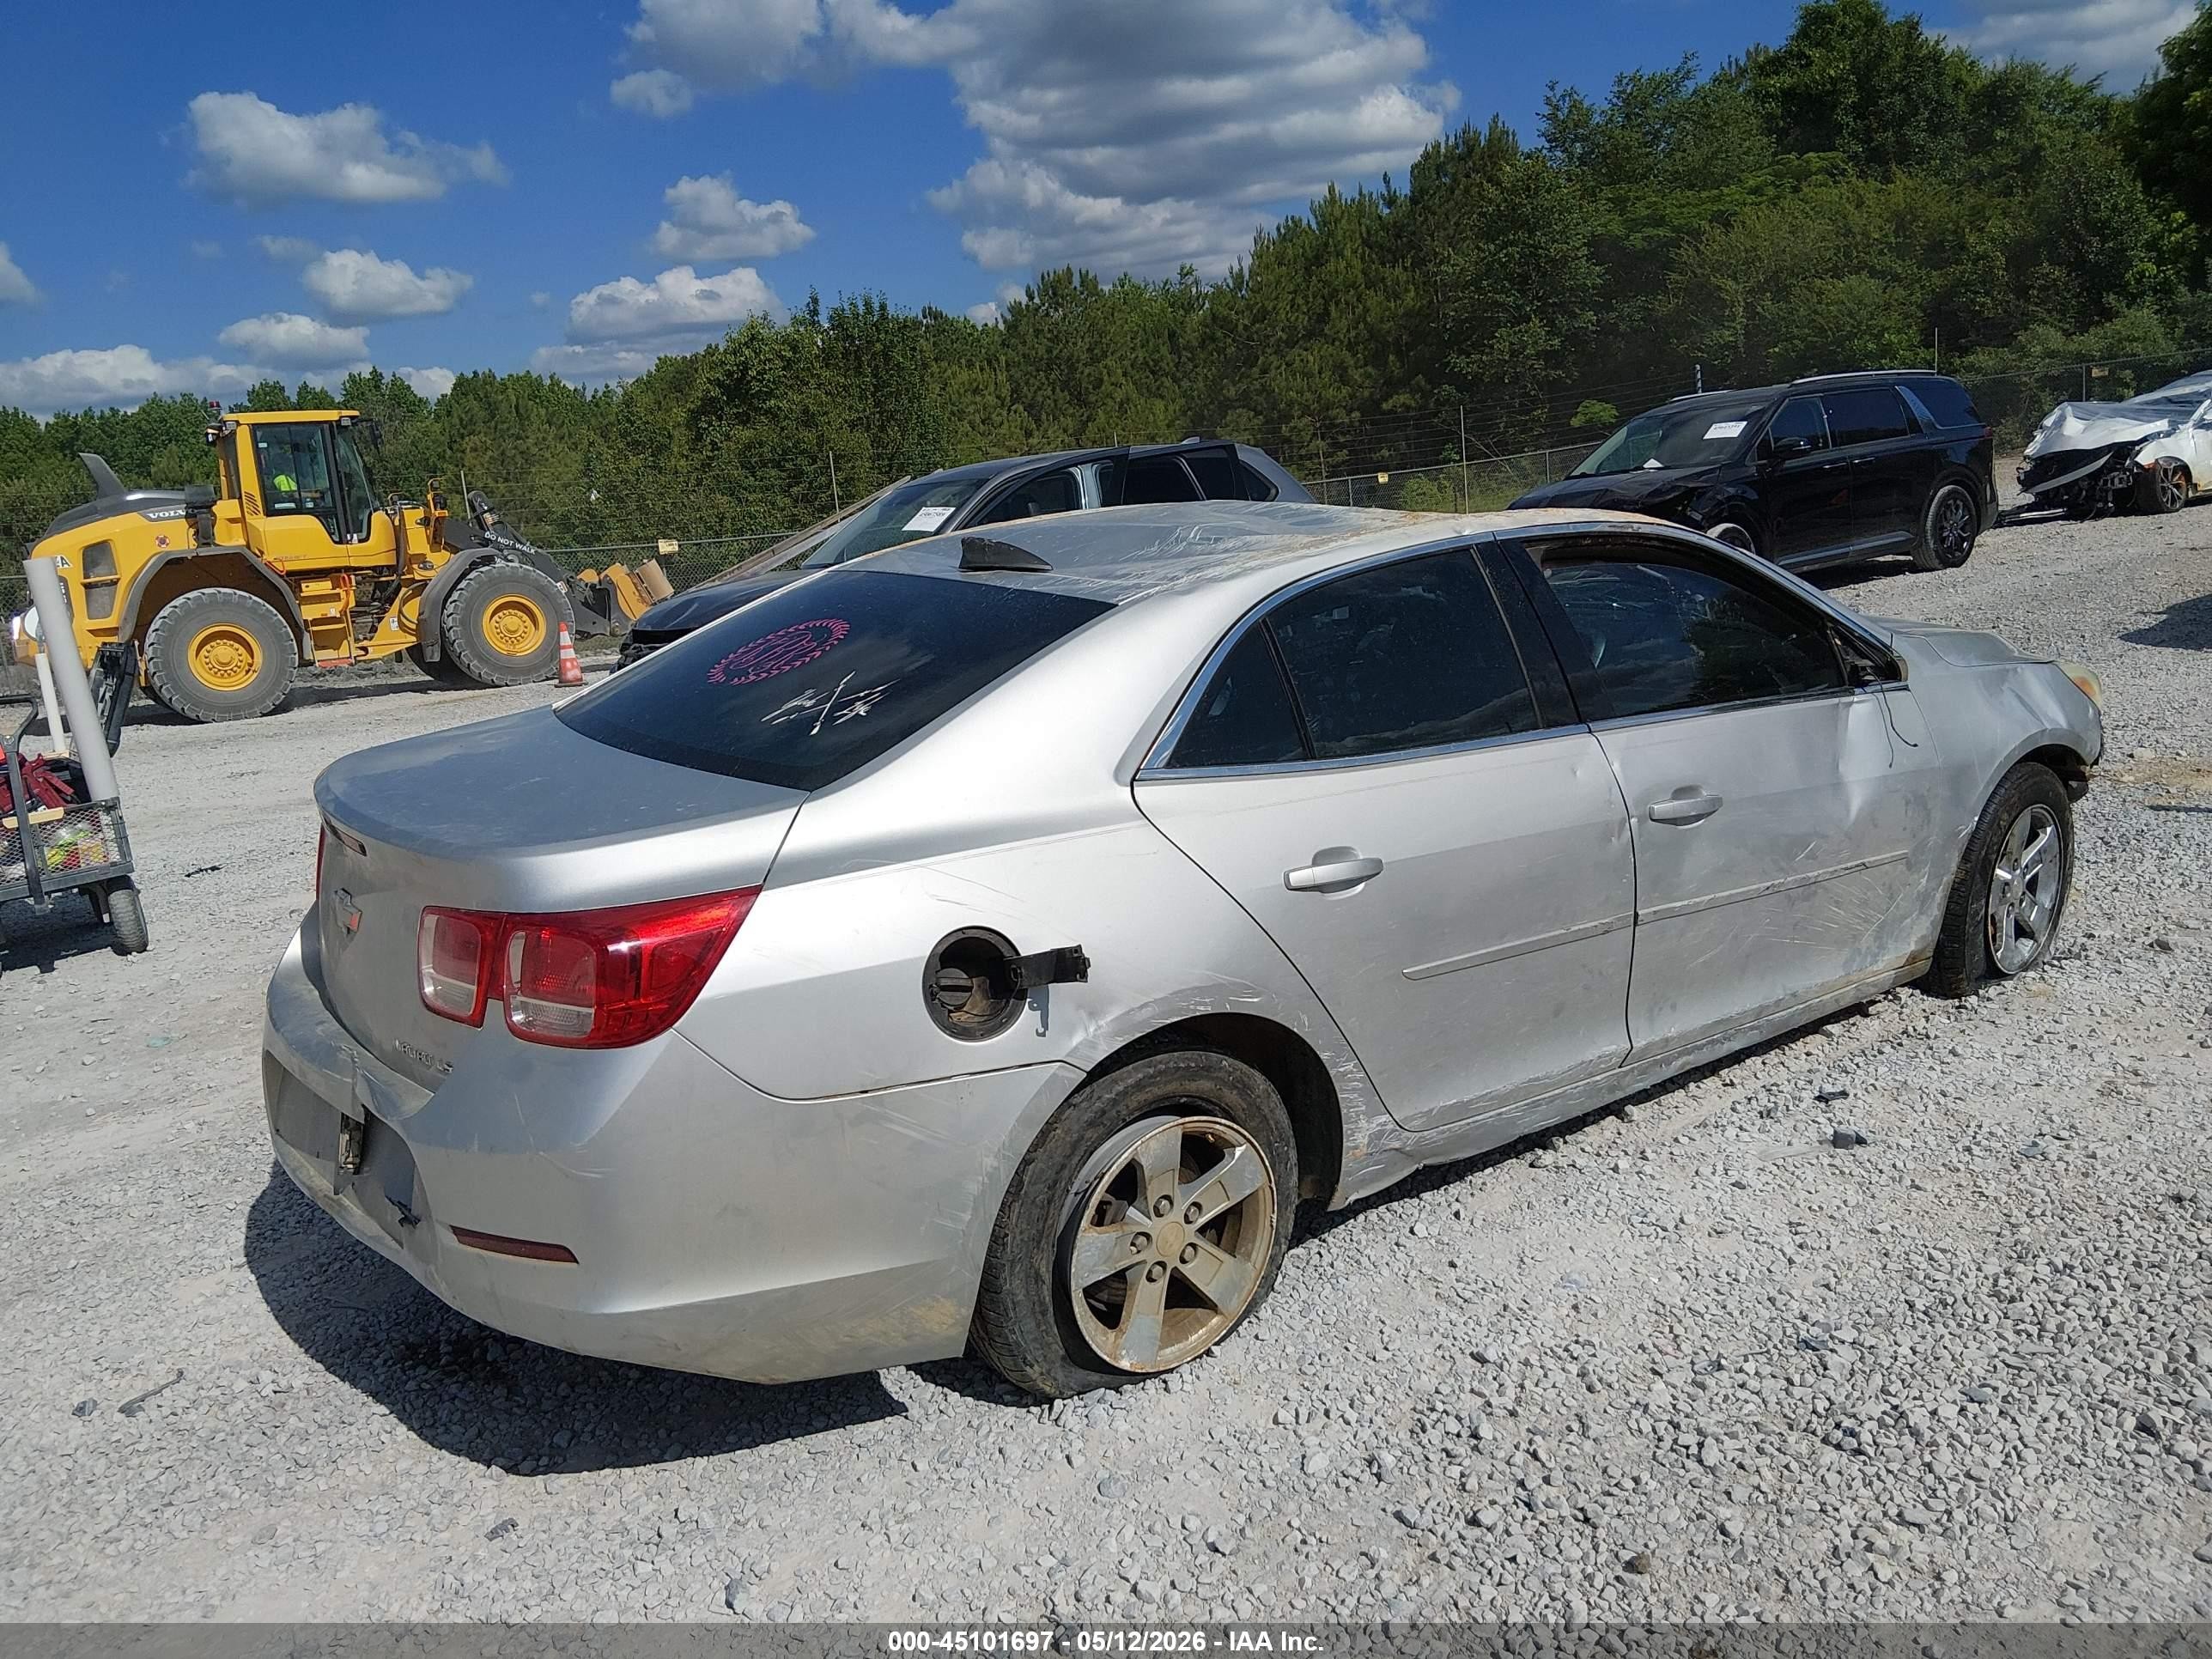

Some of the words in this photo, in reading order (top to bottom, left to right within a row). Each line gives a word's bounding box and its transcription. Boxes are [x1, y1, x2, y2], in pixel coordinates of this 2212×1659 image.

[146, 509, 186, 520] VOLV
[484, 532, 496, 541] DO
[497, 536, 514, 547] NOT
[515, 542, 536, 555] WALK
